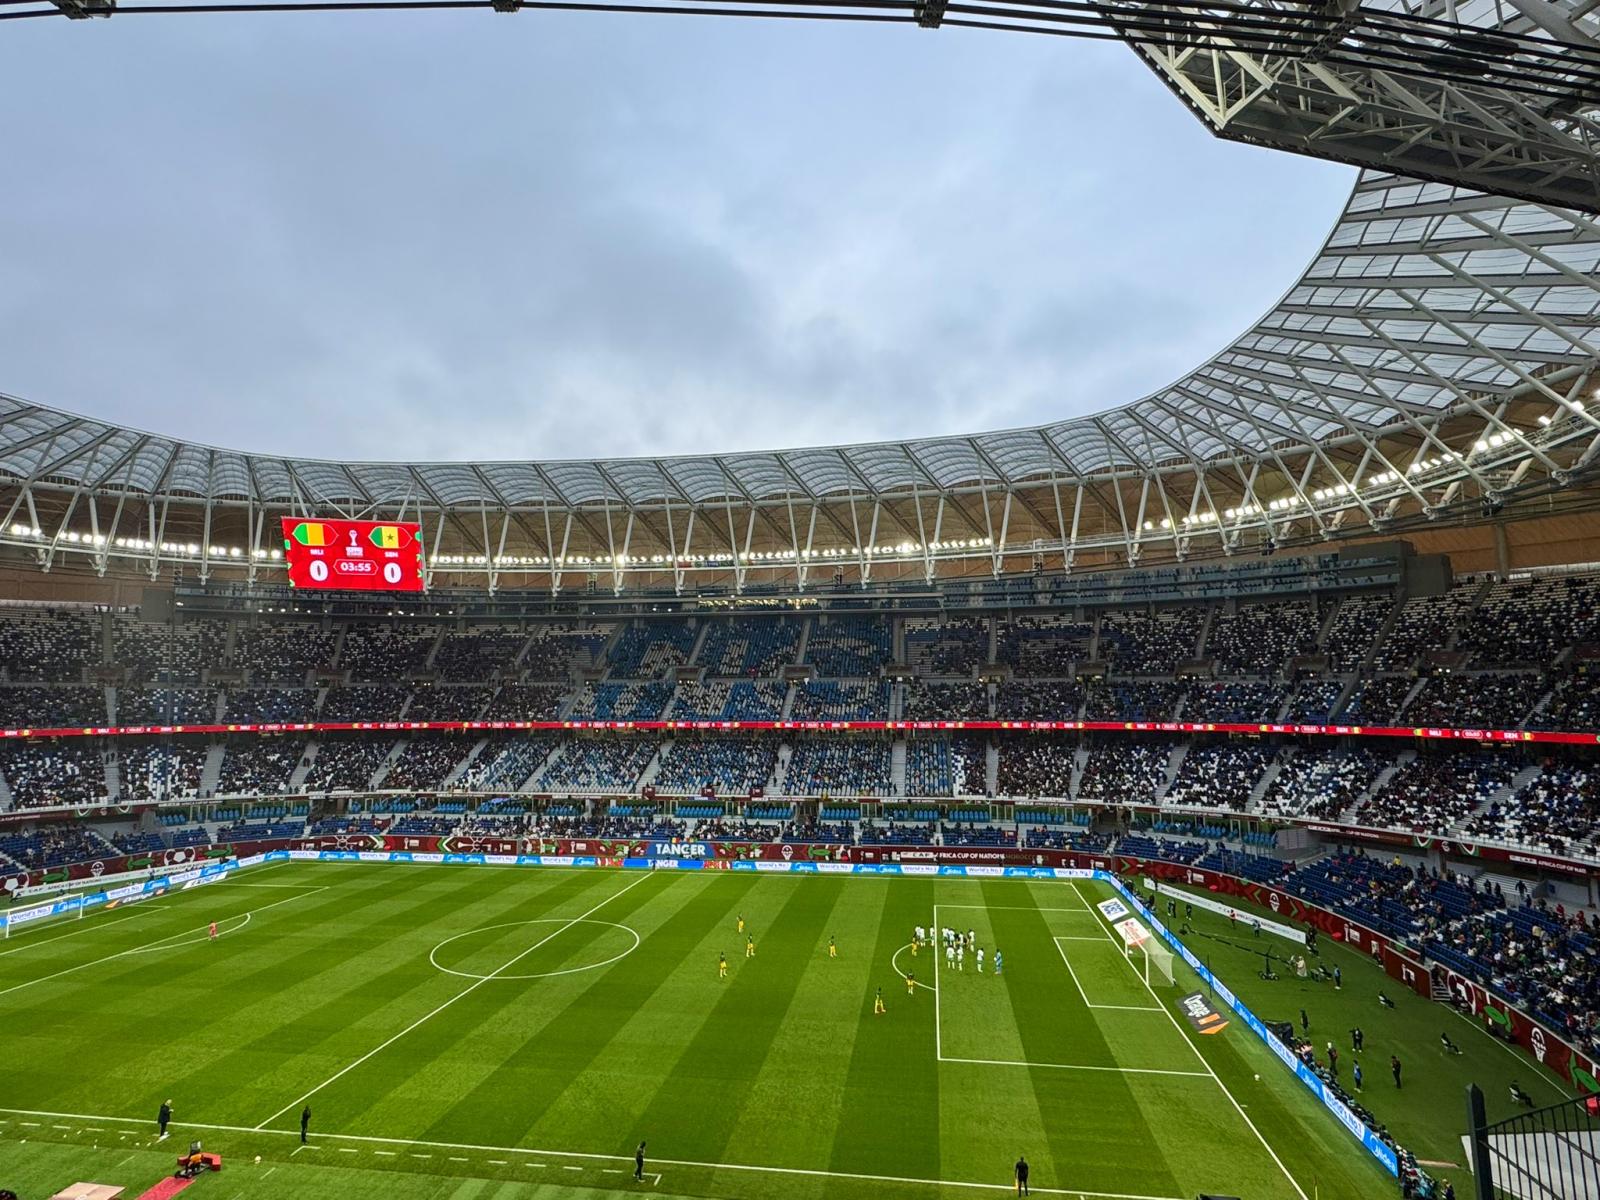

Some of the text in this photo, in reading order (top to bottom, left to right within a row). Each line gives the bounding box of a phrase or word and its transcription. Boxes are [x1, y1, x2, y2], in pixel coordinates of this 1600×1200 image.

[309, 560, 328, 581] 0
[340, 562, 371, 572] 03:55
[384, 562, 402, 584] 0
[655, 843, 706, 856] TANGER
[648, 859, 679, 868] TNGER
